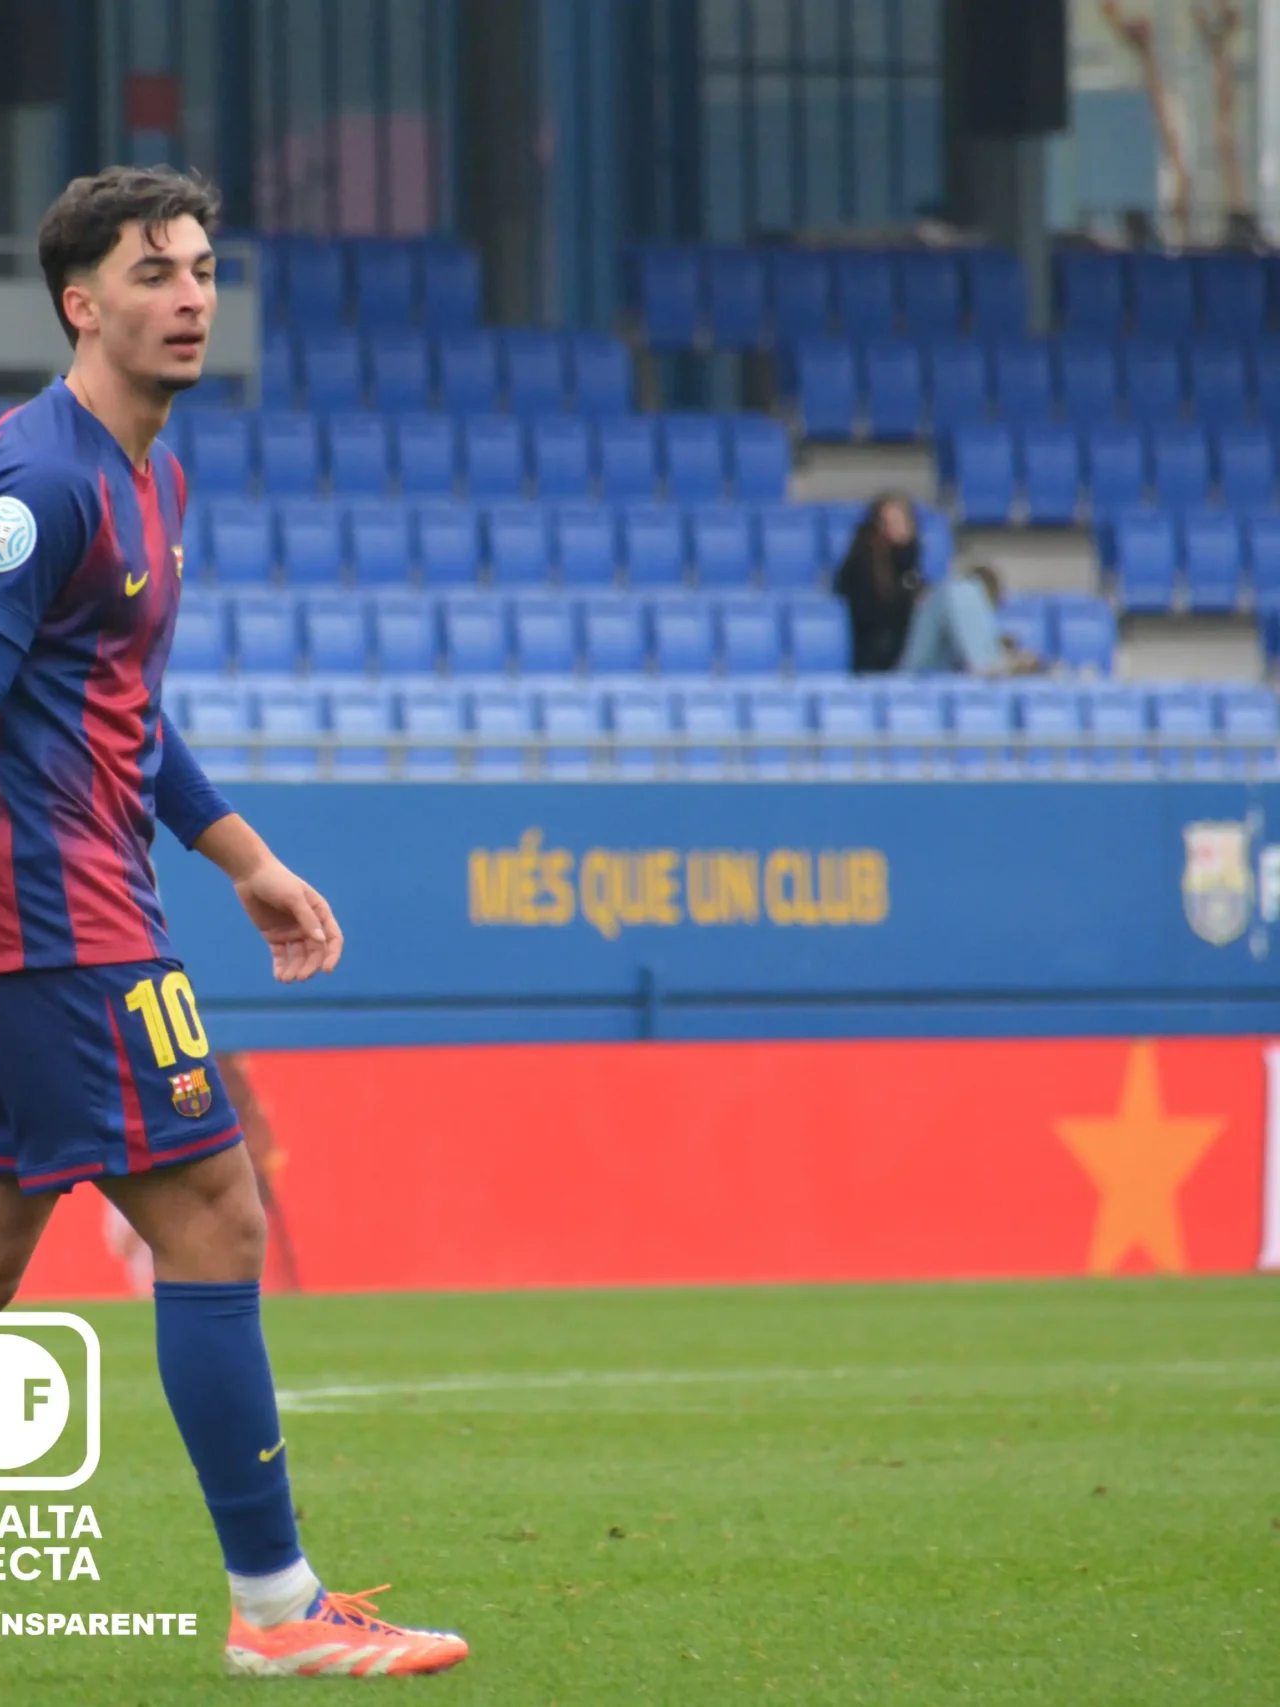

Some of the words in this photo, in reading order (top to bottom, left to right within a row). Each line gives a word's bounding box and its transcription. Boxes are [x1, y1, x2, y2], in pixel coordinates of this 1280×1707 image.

[469, 830, 576, 925] MÉS
[580, 849, 681, 938] QUE
[687, 852, 759, 925] UN
[764, 850, 888, 925] CLUB
[124, 970, 209, 1068] 10
